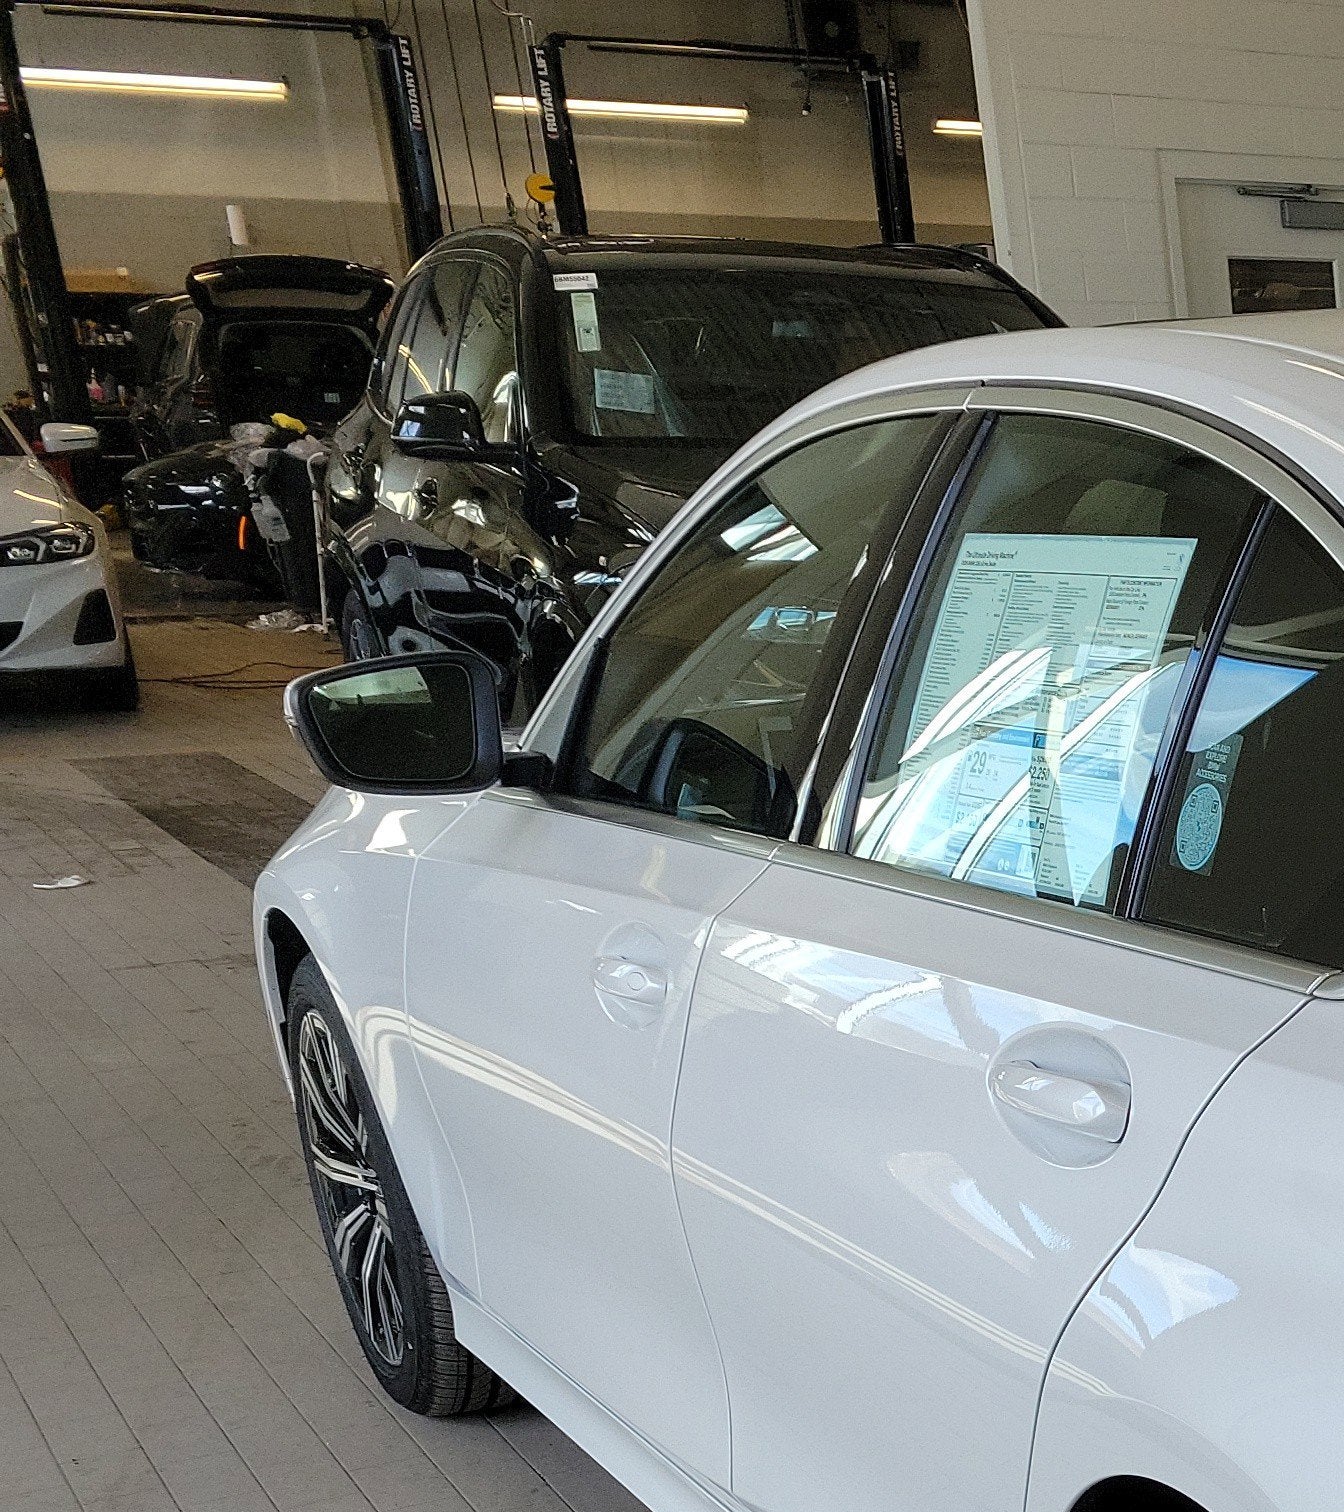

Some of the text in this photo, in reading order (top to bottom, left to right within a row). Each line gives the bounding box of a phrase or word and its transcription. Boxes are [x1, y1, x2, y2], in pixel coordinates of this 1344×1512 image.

[398, 36, 422, 125] ROTARY LIFT
[533, 47, 558, 132] ROTARY LIFT
[887, 71, 903, 149] ROTARY LIFT
[969, 750, 987, 775] 29
